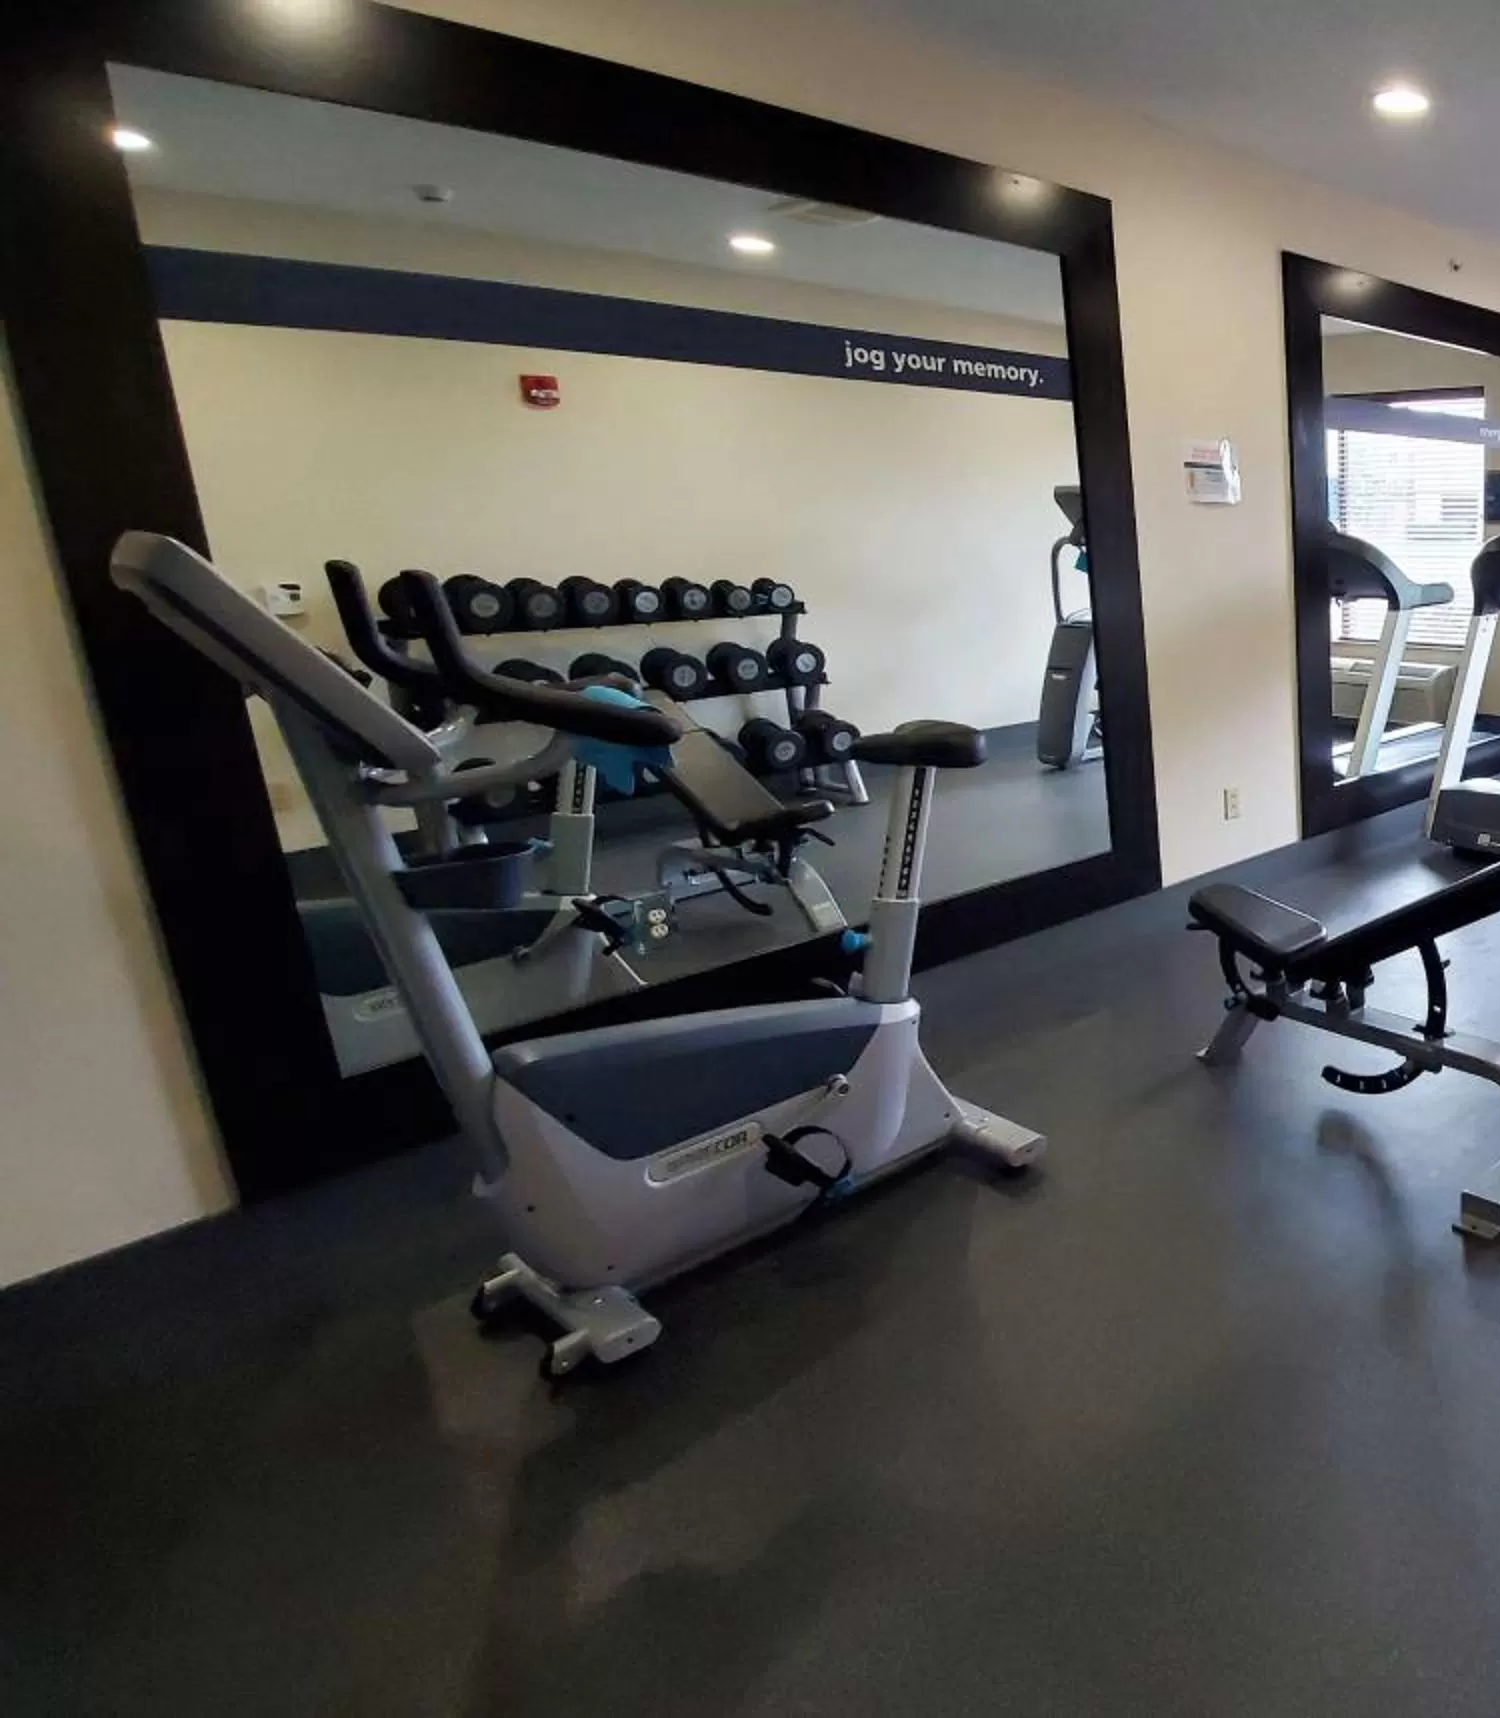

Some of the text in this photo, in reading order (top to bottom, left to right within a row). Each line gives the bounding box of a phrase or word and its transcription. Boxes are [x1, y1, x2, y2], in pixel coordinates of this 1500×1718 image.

[844, 340, 1045, 387] jog your memory.
